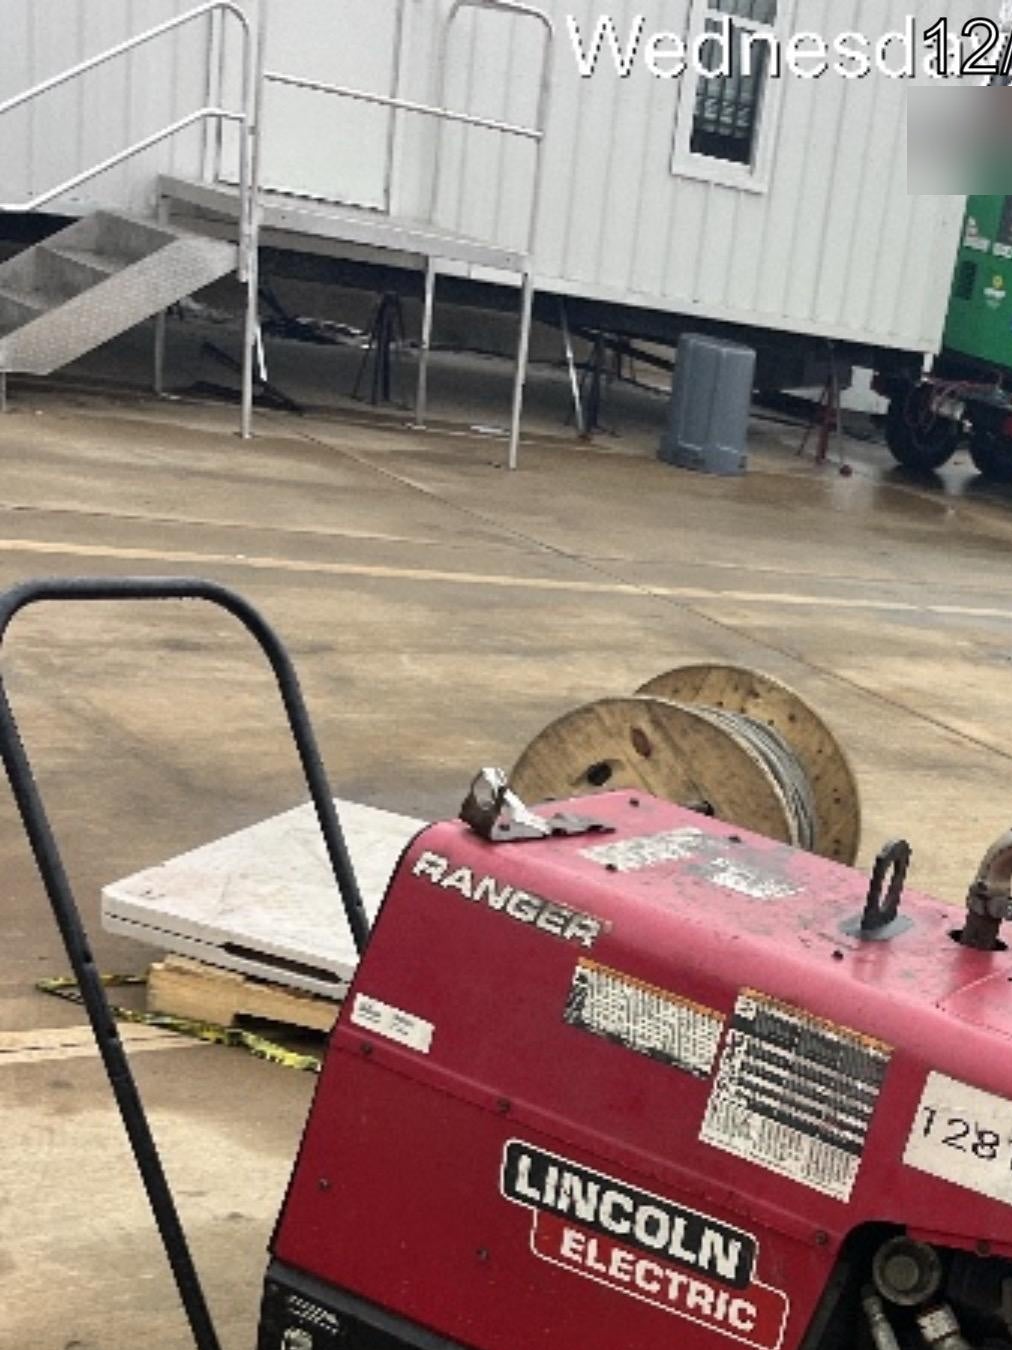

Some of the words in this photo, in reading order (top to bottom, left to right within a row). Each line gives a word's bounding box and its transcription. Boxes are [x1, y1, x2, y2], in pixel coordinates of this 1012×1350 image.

[411, 851, 601, 949] RANGER
[515, 1154, 743, 1280] LINCOLN
[560, 1226, 758, 1331] ELECTRIC
